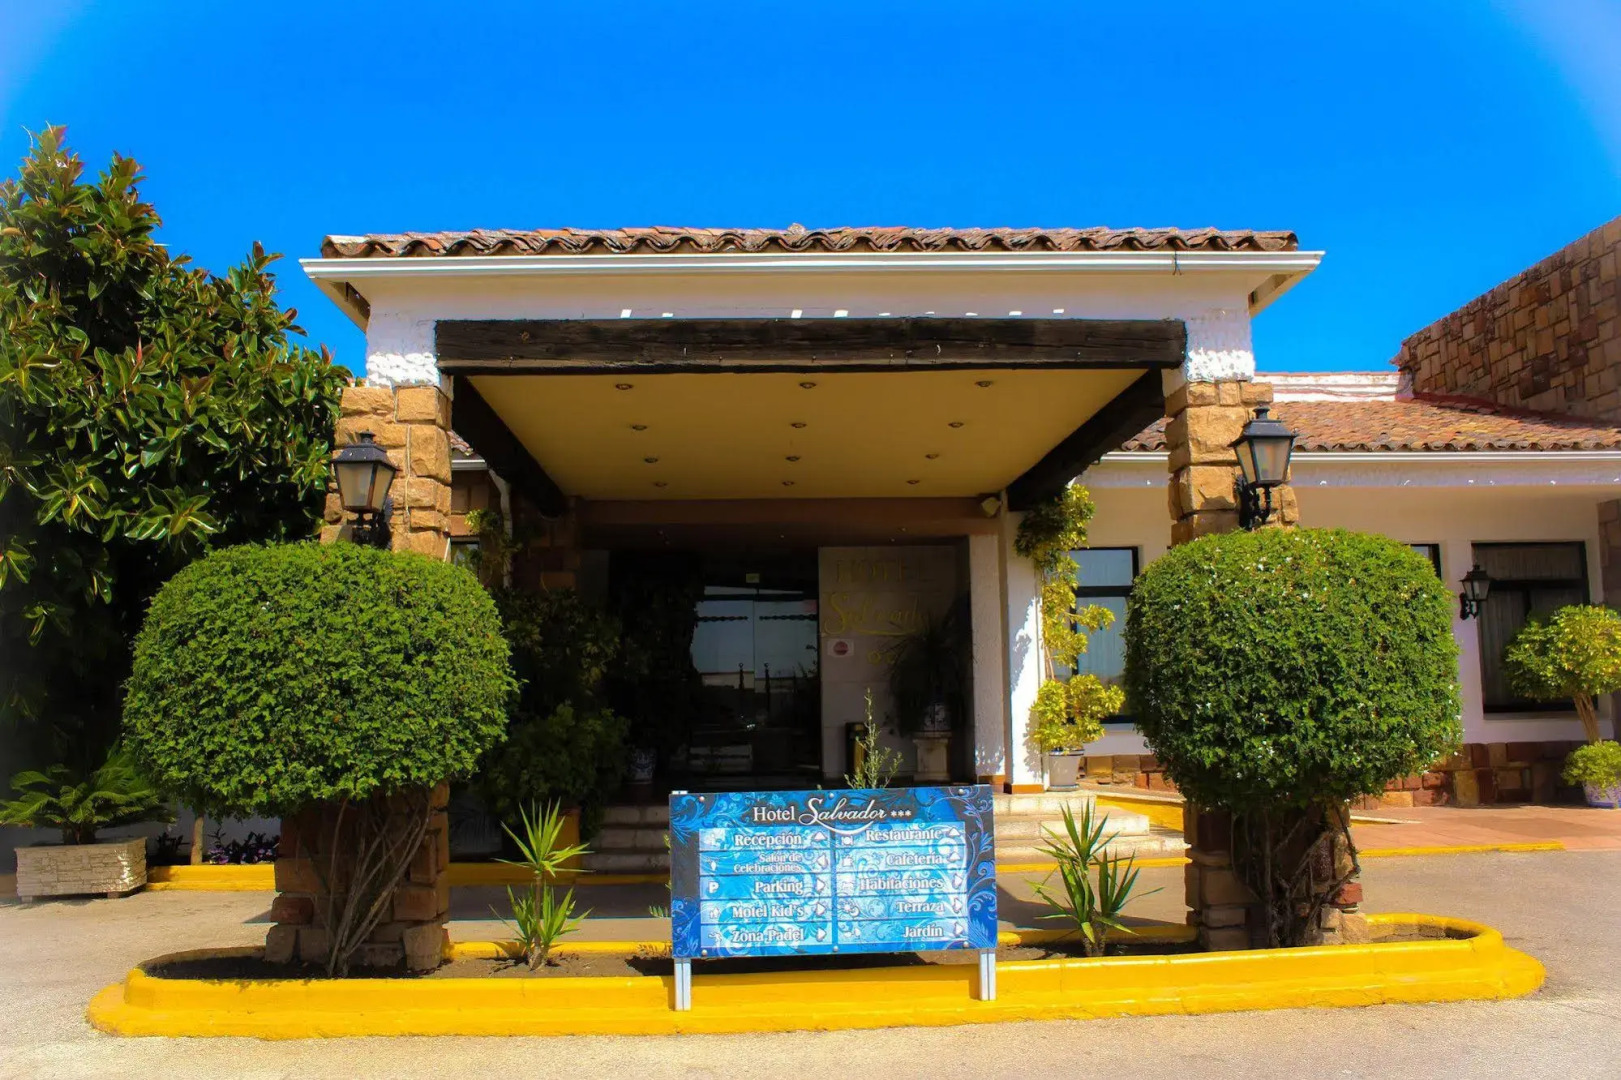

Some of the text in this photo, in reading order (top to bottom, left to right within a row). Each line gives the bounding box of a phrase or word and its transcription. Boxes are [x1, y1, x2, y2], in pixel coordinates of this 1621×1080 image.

[753, 797, 888, 835] Hotel Salvador
[733, 833, 802, 847] Recepción
[865, 829, 942, 841] Restaurante
[788, 852, 801, 862] de
[733, 862, 801, 874] Celebraciones
[754, 880, 803, 895] Parking
[859, 876, 944, 890] Habitaciones
[732, 903, 804, 918] Motel Kid's
[896, 900, 945, 913] Terraza
[732, 929, 765, 942] Zona
[903, 923, 943, 938] Jardín
